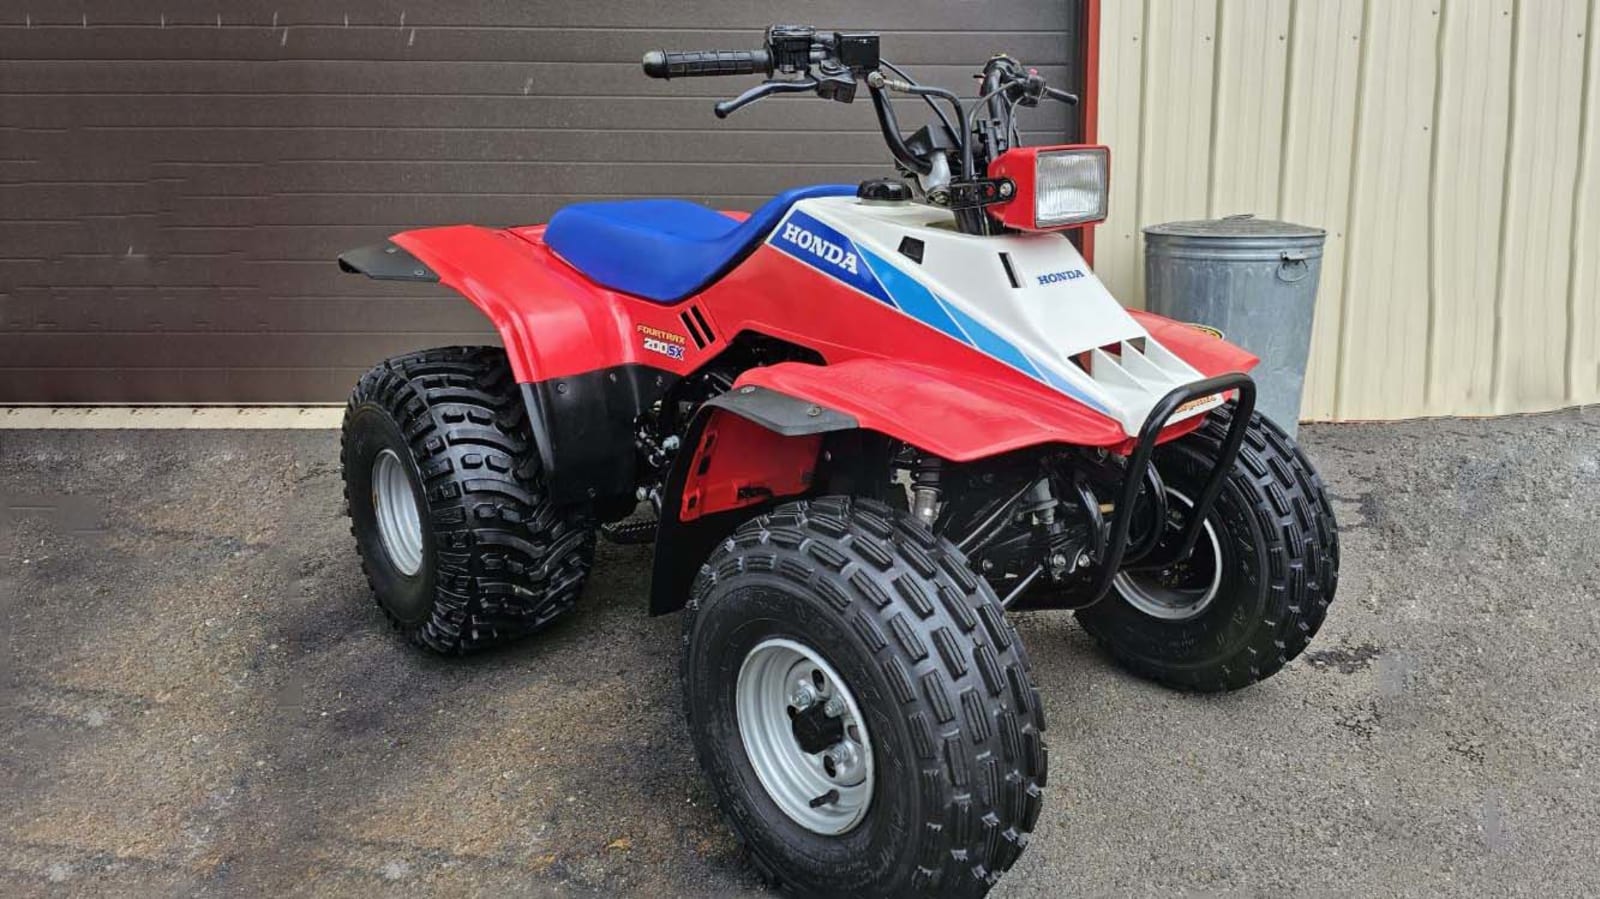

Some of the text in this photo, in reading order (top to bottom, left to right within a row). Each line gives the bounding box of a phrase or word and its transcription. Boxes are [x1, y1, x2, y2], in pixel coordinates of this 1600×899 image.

[782, 222, 858, 275] HONDA
[1037, 269, 1085, 285] HONDA
[636, 324, 686, 345] FOURTRAX
